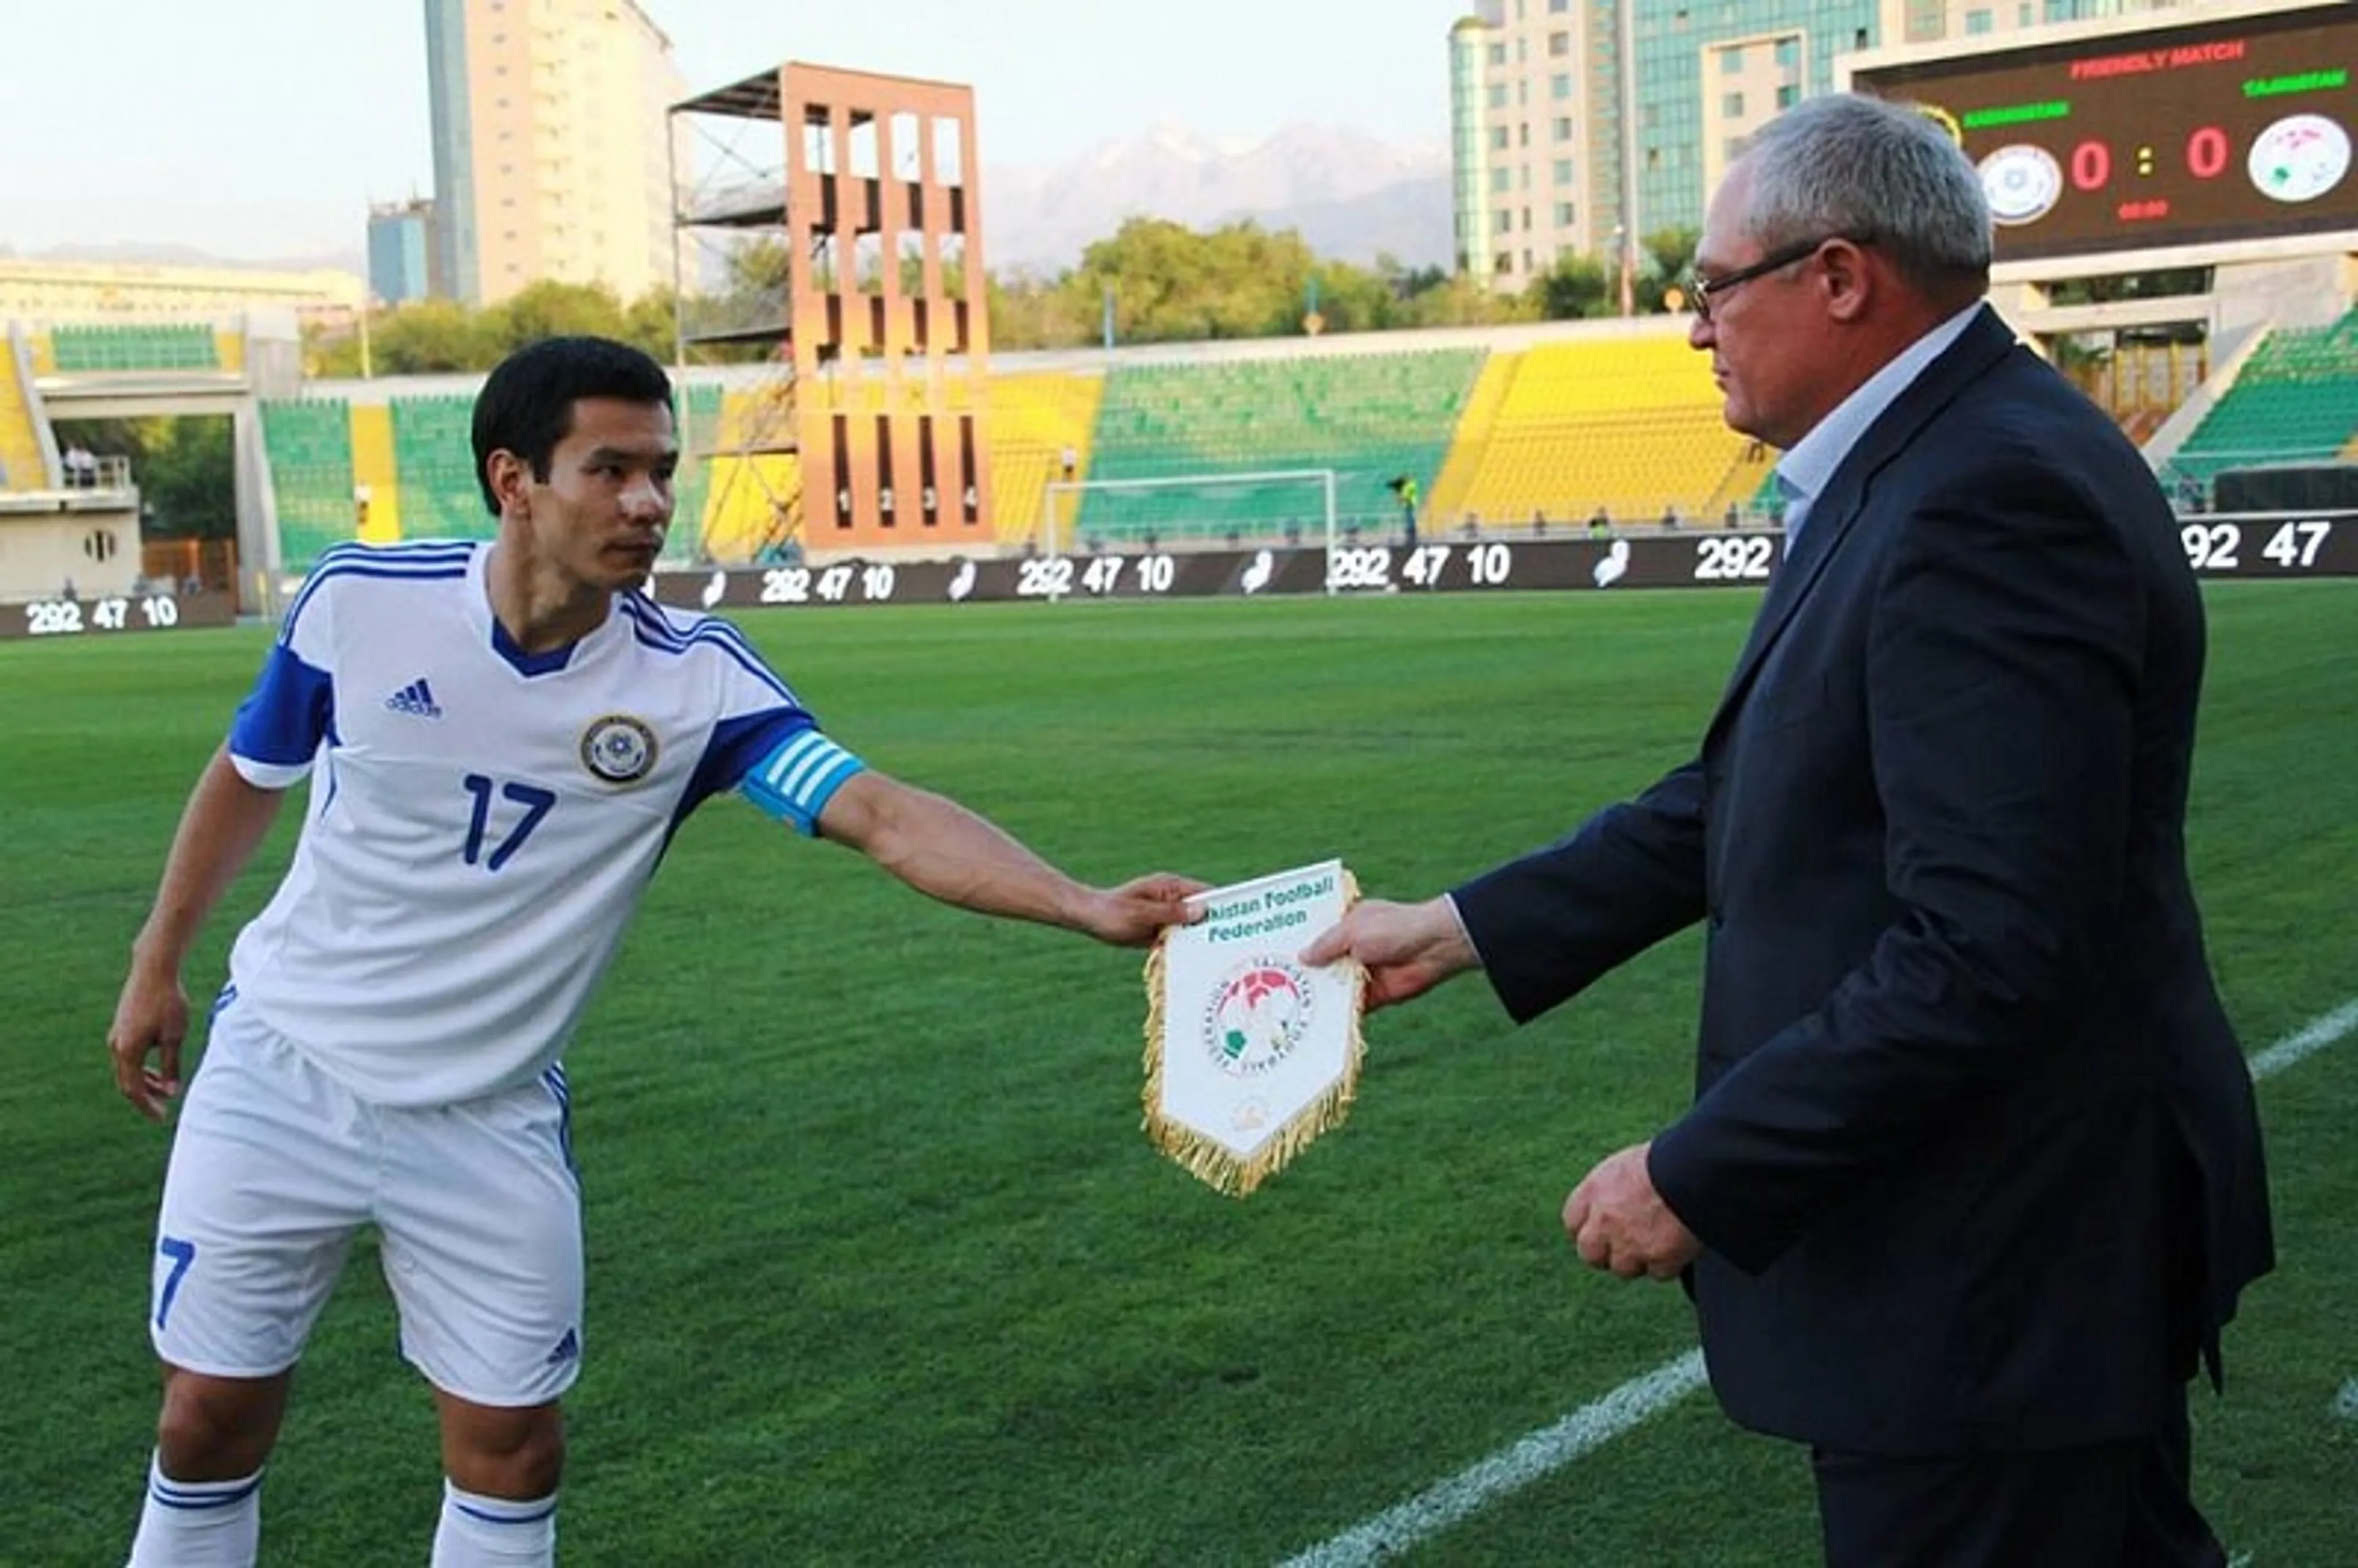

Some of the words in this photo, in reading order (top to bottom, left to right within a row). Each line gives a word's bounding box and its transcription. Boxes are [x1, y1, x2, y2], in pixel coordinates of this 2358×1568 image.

[2071, 51, 2169, 80] FRIENDLY
[2170, 41, 2244, 69] MATCH
[2072, 141, 2110, 190] 0
[2187, 127, 2228, 178] 0
[1326, 548, 1391, 586] 292
[1402, 545, 1451, 584] 47
[1467, 544, 1511, 584] 10
[1694, 535, 1773, 579] 292
[2181, 524, 2241, 569] 92
[2262, 521, 2331, 567] 47
[760, 568, 811, 603] 292
[816, 567, 853, 600] 47
[862, 565, 894, 600] 10
[1016, 558, 1074, 594] 292
[1082, 556, 1124, 592] 47
[1136, 556, 1174, 591] 10
[26, 601, 84, 634] 292
[92, 599, 128, 629] 47
[141, 597, 178, 626] 10
[383, 698, 442, 718] adidas
[463, 774, 557, 871] 17
[1208, 898, 1261, 922] kistan
[1264, 875, 1334, 909] Football
[1208, 909, 1307, 942] Federation
[157, 1236, 195, 1332] 7
